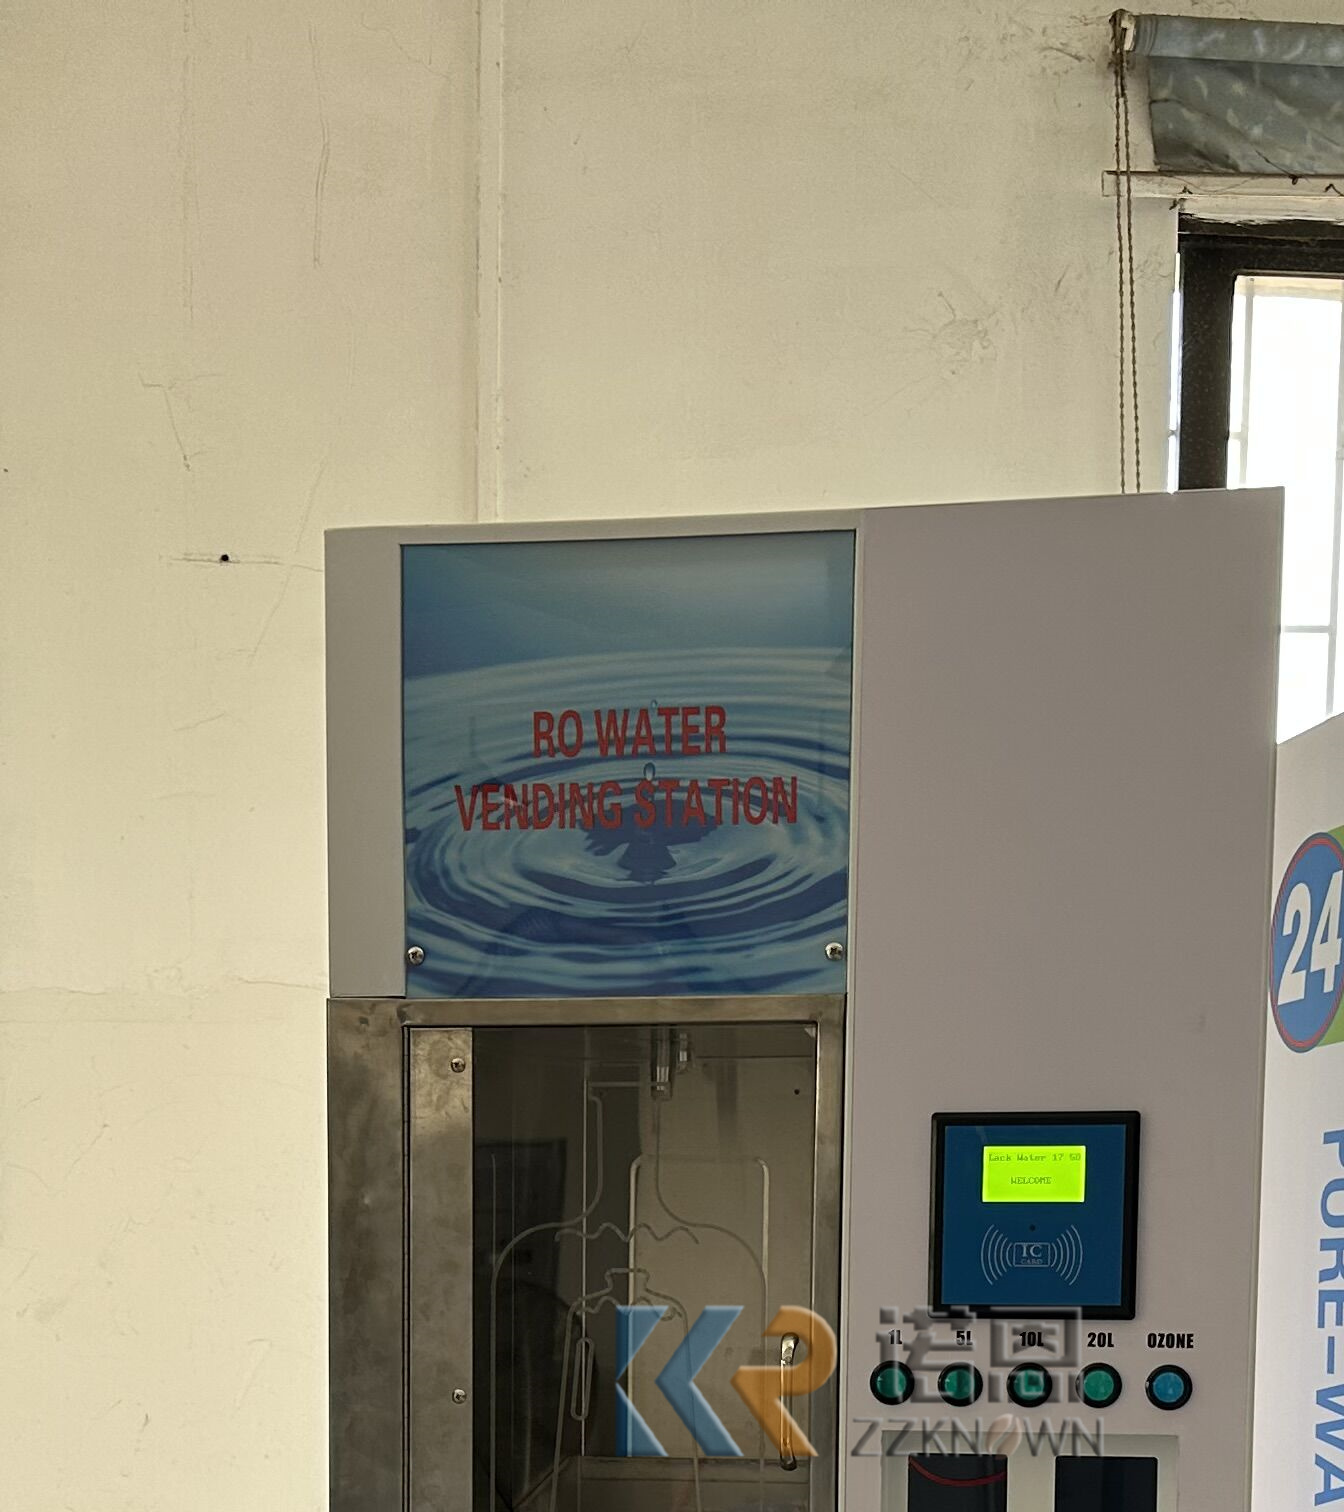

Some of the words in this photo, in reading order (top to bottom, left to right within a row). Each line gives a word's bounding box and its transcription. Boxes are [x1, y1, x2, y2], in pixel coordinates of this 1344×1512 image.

[533, 710, 583, 758] RO
[594, 706, 727, 756] WATER
[455, 783, 621, 831] VENDING
[632, 776, 798, 829] STATION
[1277, 870, 1343, 1006] 24
[1011, 1176, 1052, 1185] WELCOME
[1022, 1244, 1042, 1258] IC
[888, 1330, 902, 1345] 1L
[956, 1331, 973, 1346] 5L
[1019, 1332, 1044, 1347] 10L
[1087, 1332, 1114, 1348] 20L
[1147, 1333, 1194, 1349] OZONE
